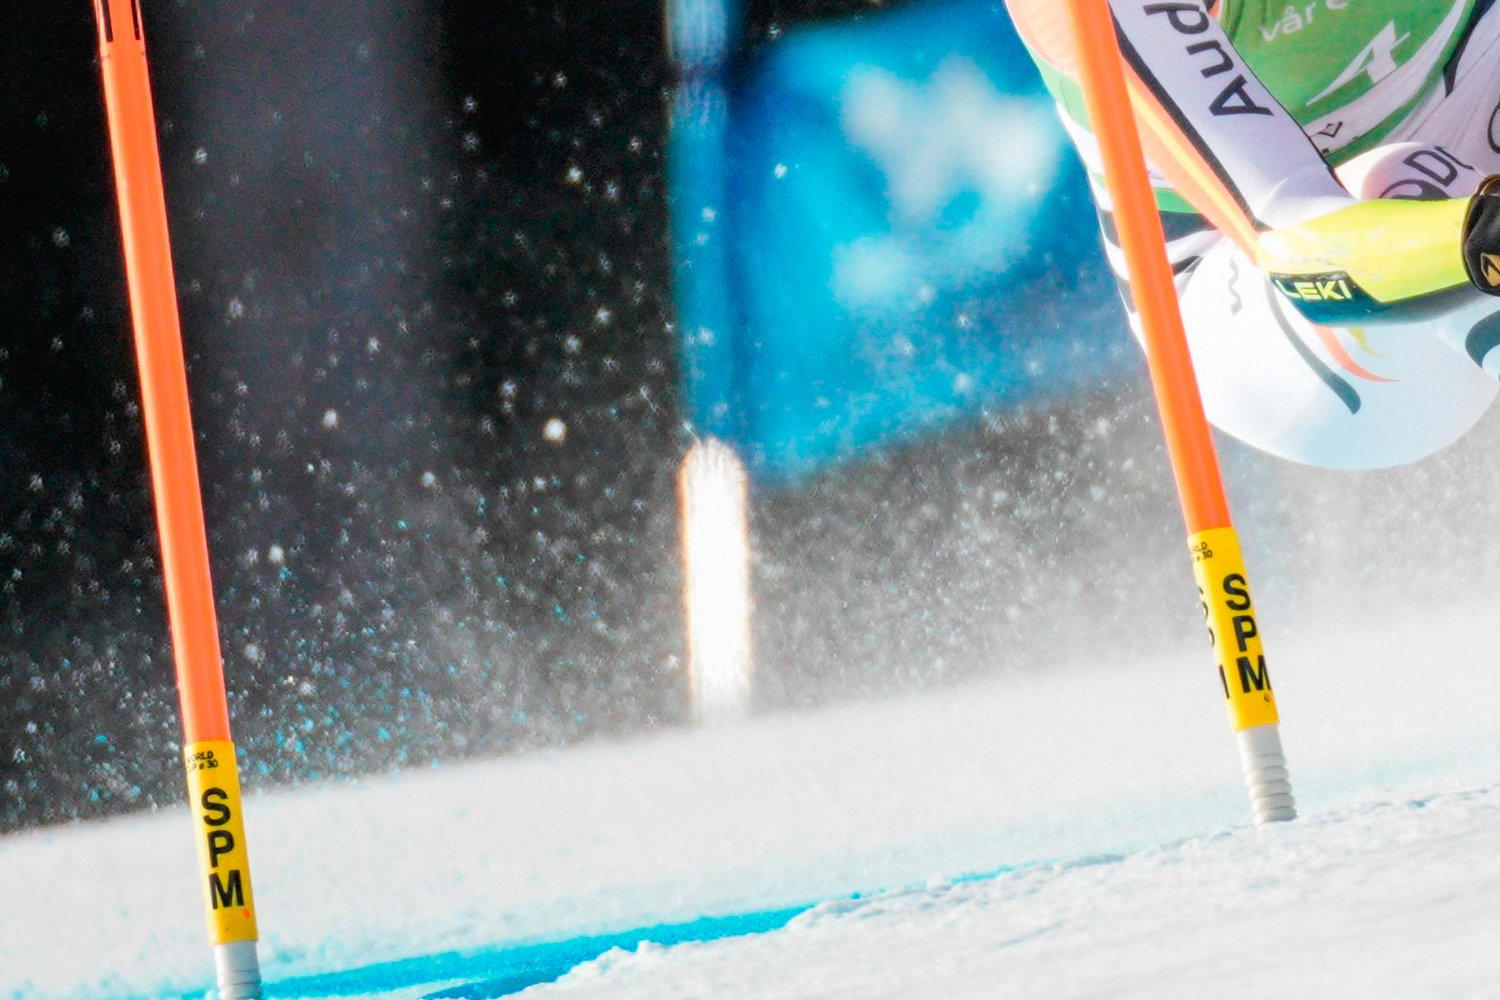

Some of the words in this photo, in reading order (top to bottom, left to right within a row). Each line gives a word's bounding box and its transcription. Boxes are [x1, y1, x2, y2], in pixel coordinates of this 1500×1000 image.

[1259, 2, 1316, 42] vår
[1273, 279, 1353, 300] LEKI
[1222, 573, 1272, 694] SPM
[201, 787, 245, 910] SPM
